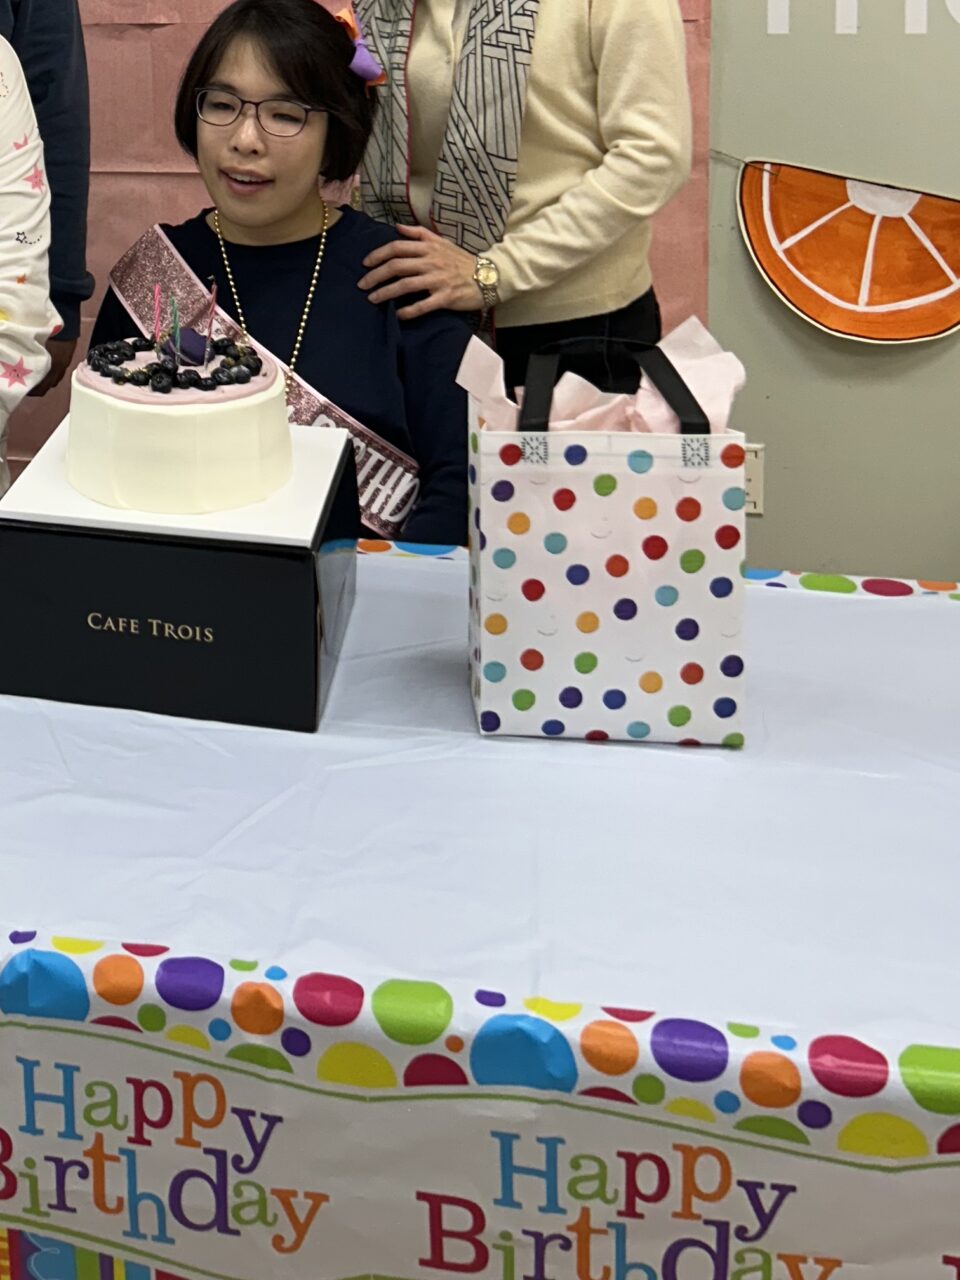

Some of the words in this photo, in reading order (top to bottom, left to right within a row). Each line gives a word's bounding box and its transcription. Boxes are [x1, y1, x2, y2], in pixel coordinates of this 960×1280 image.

[87, 612, 140, 634] CAFE
[147, 618, 214, 642] TROIS
[16, 1055, 284, 1175] Happy
[490, 1130, 797, 1242] Happy
